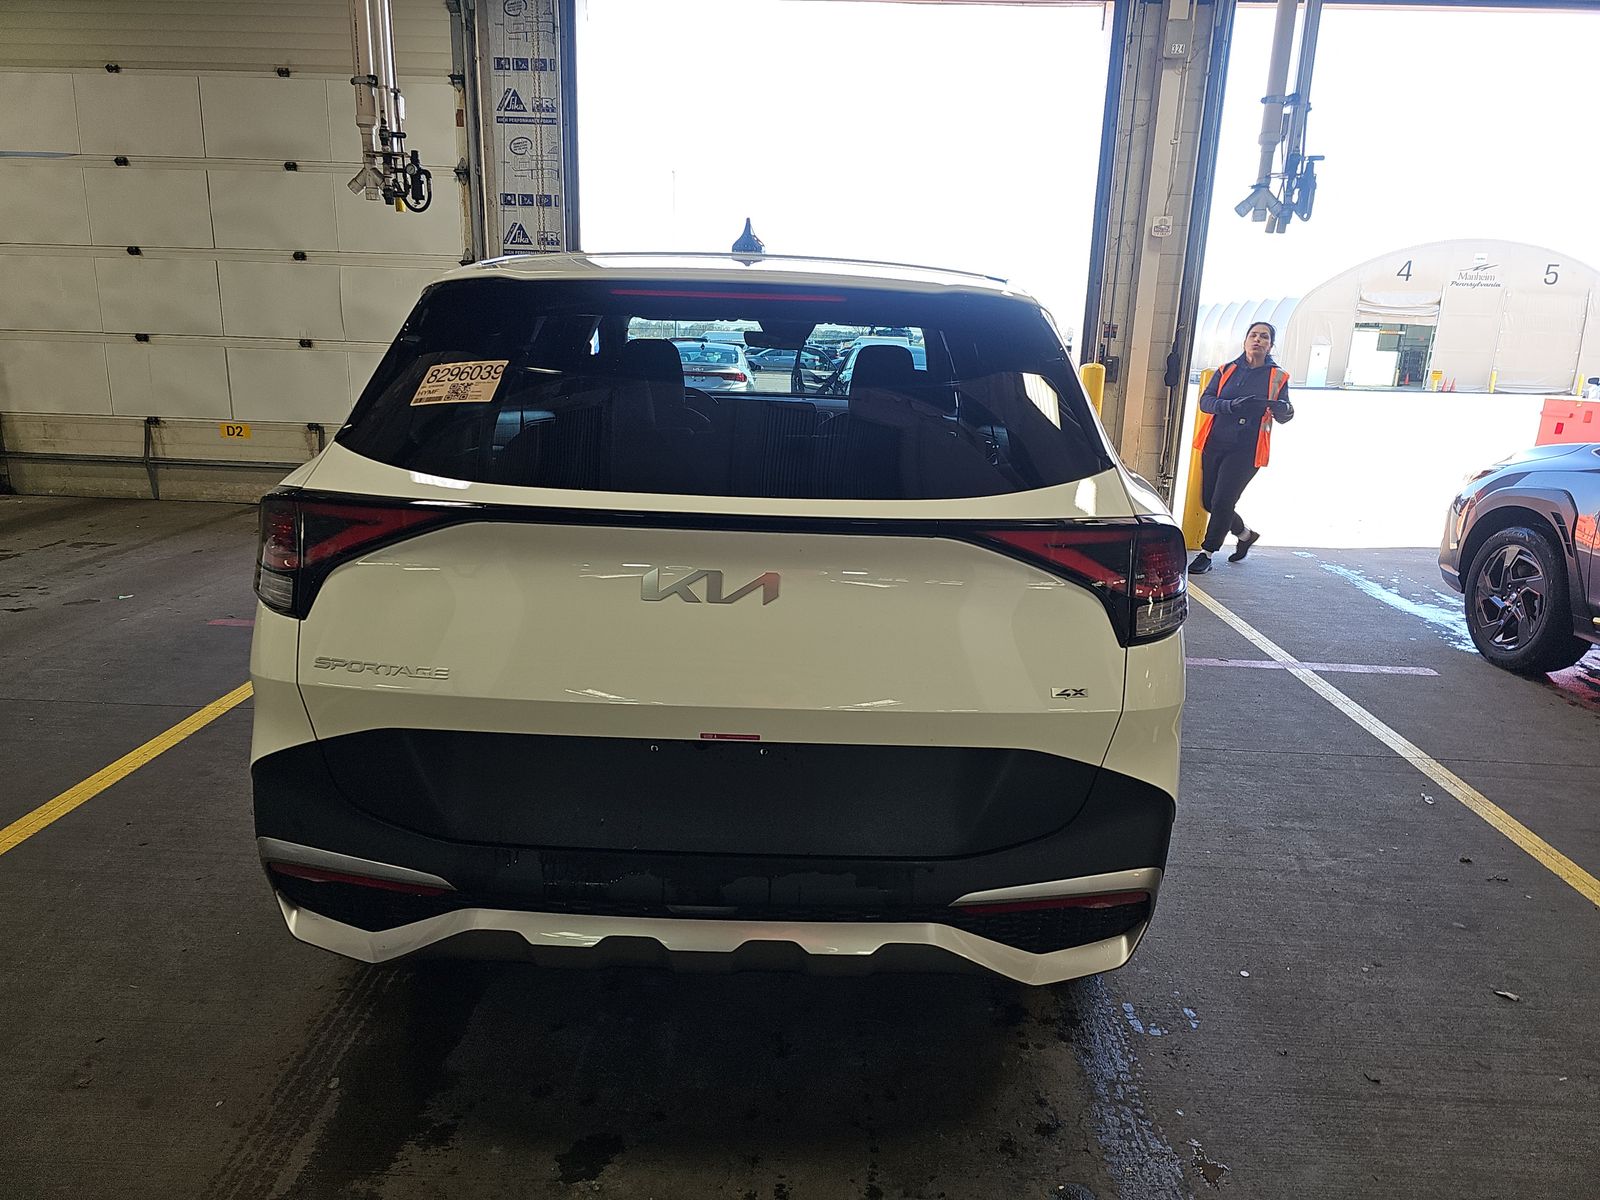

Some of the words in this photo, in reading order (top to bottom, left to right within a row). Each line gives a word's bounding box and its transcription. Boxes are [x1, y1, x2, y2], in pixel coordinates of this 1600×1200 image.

[506, 96, 524, 110] Sika
[512, 230, 529, 243] Sika
[1396, 260, 1413, 282] 4
[1457, 271, 1496, 281] Manheim
[1544, 264, 1560, 285] 5
[1450, 280, 1501, 288] Pennsylvania
[427, 364, 505, 384] 8296039
[226, 425, 244, 437] D2
[641, 568, 780, 606] KIA
[314, 656, 449, 680] SPORTAGE
[1055, 688, 1086, 698] 4X
